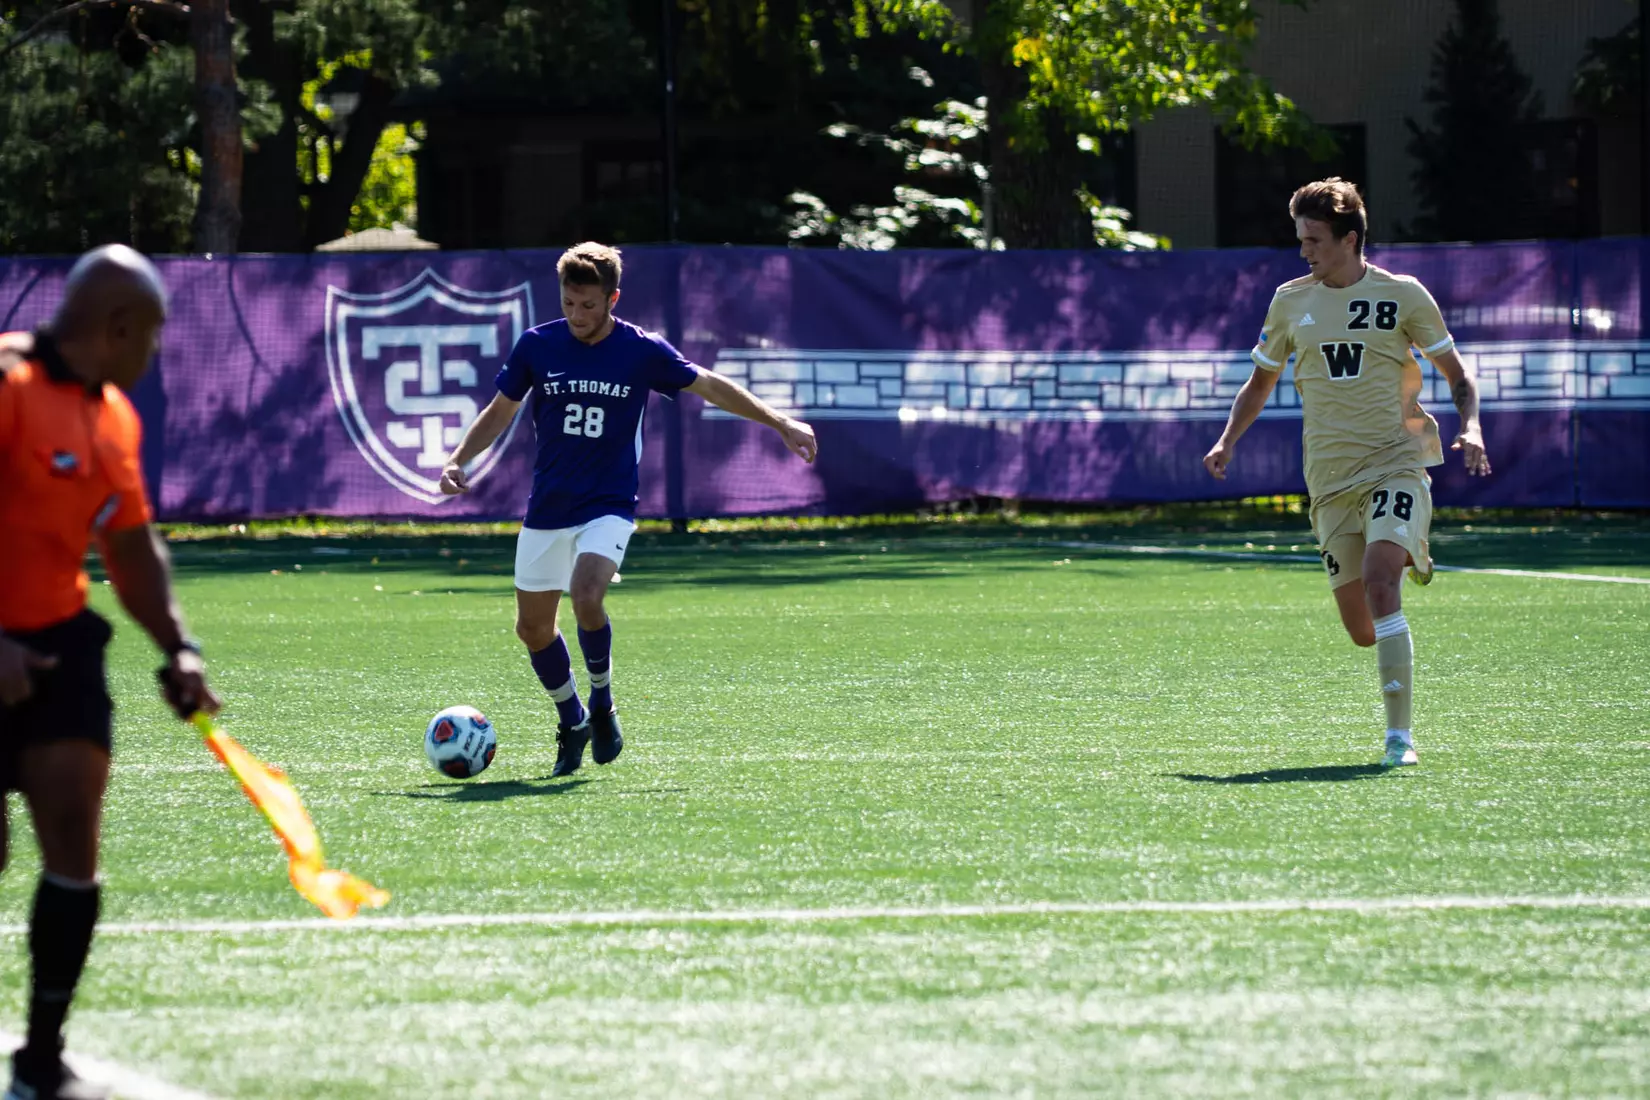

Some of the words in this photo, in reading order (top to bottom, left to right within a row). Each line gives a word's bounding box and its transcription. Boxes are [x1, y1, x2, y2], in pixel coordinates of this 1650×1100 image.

[1347, 300, 1399, 331] 28
[1319, 341, 1366, 380] W
[543, 381, 566, 395] ST.
[568, 380, 632, 398] THOMAS
[563, 403, 605, 438] 28
[1371, 488, 1415, 523] 28
